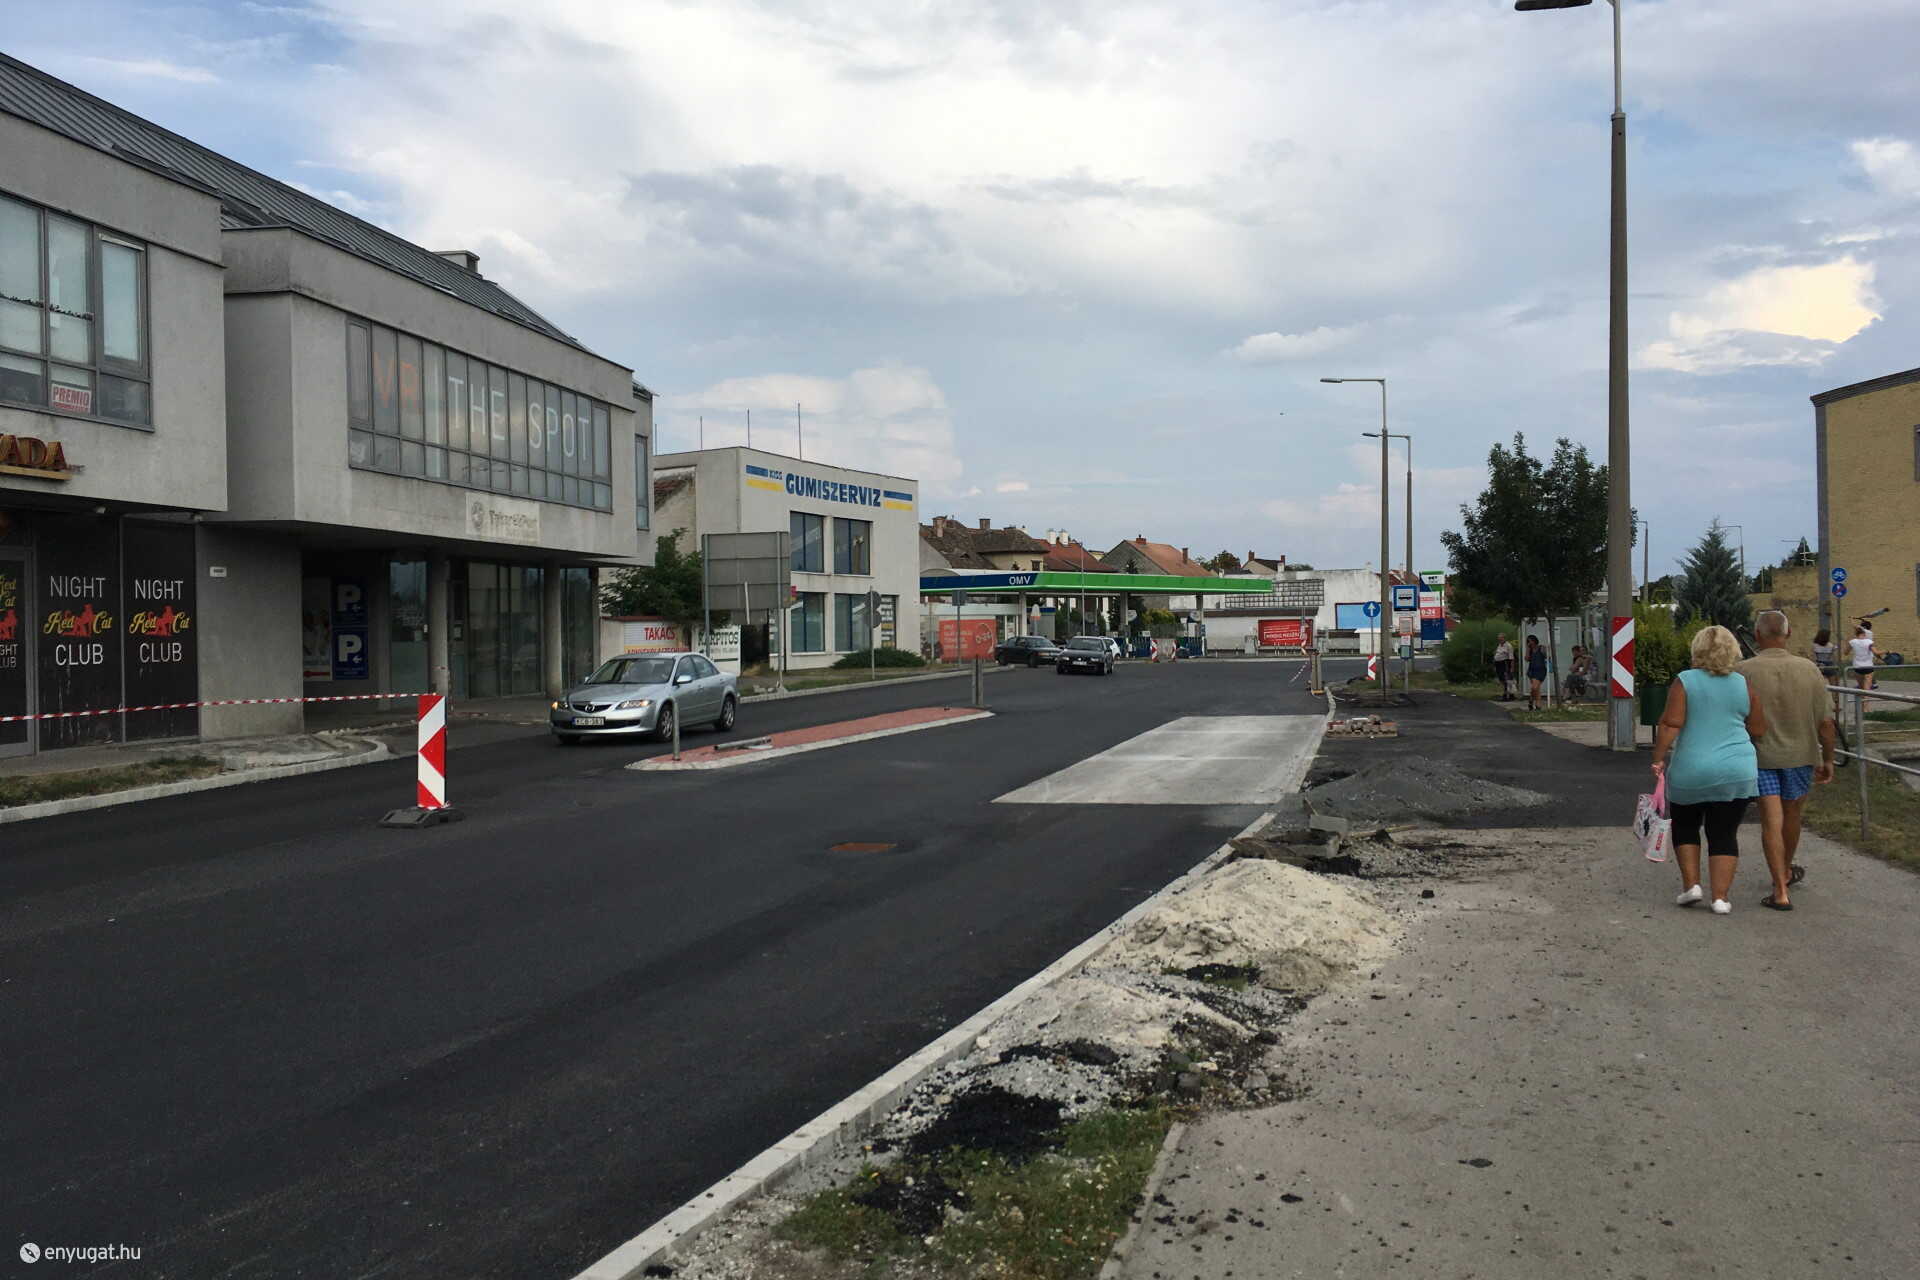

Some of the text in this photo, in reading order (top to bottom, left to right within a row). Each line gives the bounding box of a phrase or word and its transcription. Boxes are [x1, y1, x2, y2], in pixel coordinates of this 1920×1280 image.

[373, 351, 420, 411] VR
[447, 375, 590, 462] THE SPOT
[0, 433, 67, 471] ADA
[785, 472, 882, 507] GUMISZERVIZ
[50, 575, 106, 598] NIGHT
[135, 579, 184, 601] NIGHT
[1008, 575, 1031, 586] OMV
[43, 610, 113, 634] Red Cat
[129, 611, 190, 635] Red Cat
[339, 634, 362, 663] P
[697, 631, 739, 647] KRPITOS
[55, 643, 104, 666] CLUB
[139, 642, 183, 664] CLUB
